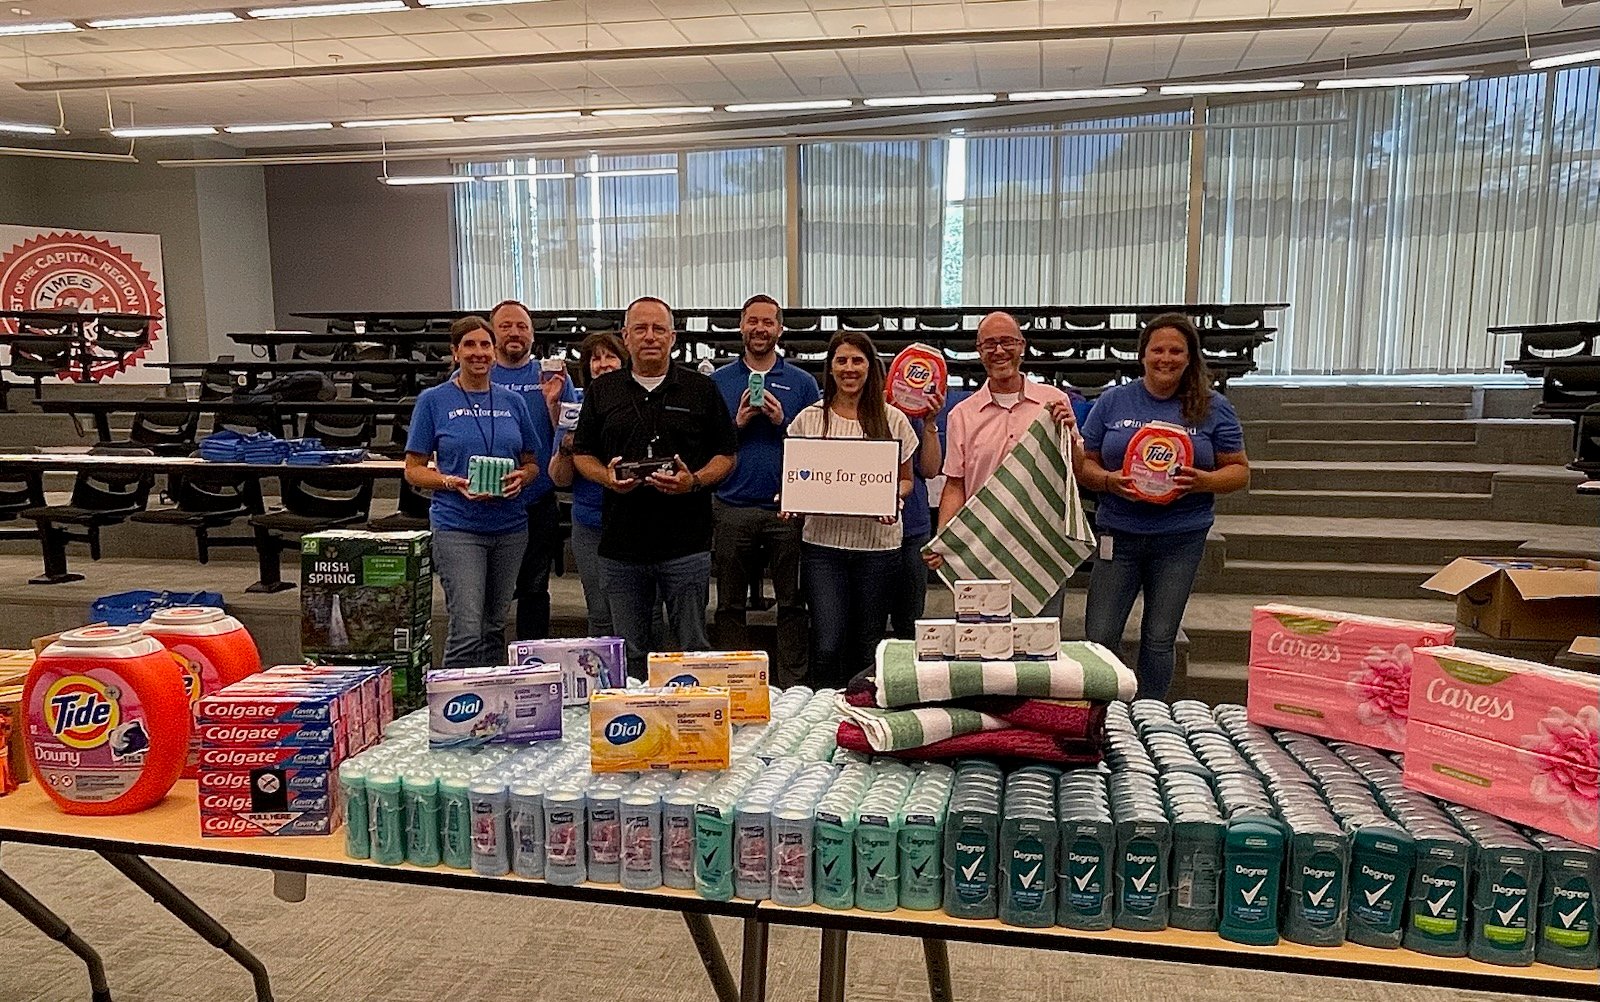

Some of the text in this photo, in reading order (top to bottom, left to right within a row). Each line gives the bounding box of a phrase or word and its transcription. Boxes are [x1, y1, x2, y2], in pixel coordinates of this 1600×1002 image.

[19, 266, 39, 282] THE
[35, 252, 98, 268] CAPITAL
[99, 261, 140, 305] REGION
[40, 276, 93, 301] TIMES
[906, 364, 930, 379] Tide
[1145, 446, 1173, 461] Tide
[836, 469, 856, 482] for
[860, 471, 892, 486] good
[314, 561, 349, 572] IRISH
[308, 574, 356, 584] SPRING
[1267, 631, 1341, 663] Caress
[759, 671, 767, 680] 8
[549, 684, 558, 694] 8
[1426, 678, 1514, 721] Caress
[51, 691, 112, 736] Tide
[204, 703, 277, 719] Colgate
[447, 700, 479, 716] Dial
[714, 709, 722, 720] 8
[205, 726, 279, 742] Colgate
[296, 730, 320, 738] Cavity
[609, 722, 642, 738] Dial
[35, 747, 80, 767] Downy
[204, 750, 277, 766] Colgate
[202, 773, 250, 788] Colga
[203, 795, 252, 810] Colga
[205, 817, 257, 832] Colga
[956, 842, 986, 854] Degree
[1013, 849, 1043, 862] Degree
[1069, 852, 1099, 864] Degree
[1126, 852, 1157, 864] Degree
[1235, 864, 1268, 877] Degree
[1302, 866, 1336, 878] Degree
[1361, 865, 1395, 881] Degree
[1422, 874, 1456, 888] Degree
[1492, 884, 1527, 896] Degree
[1554, 886, 1590, 899] Degree
